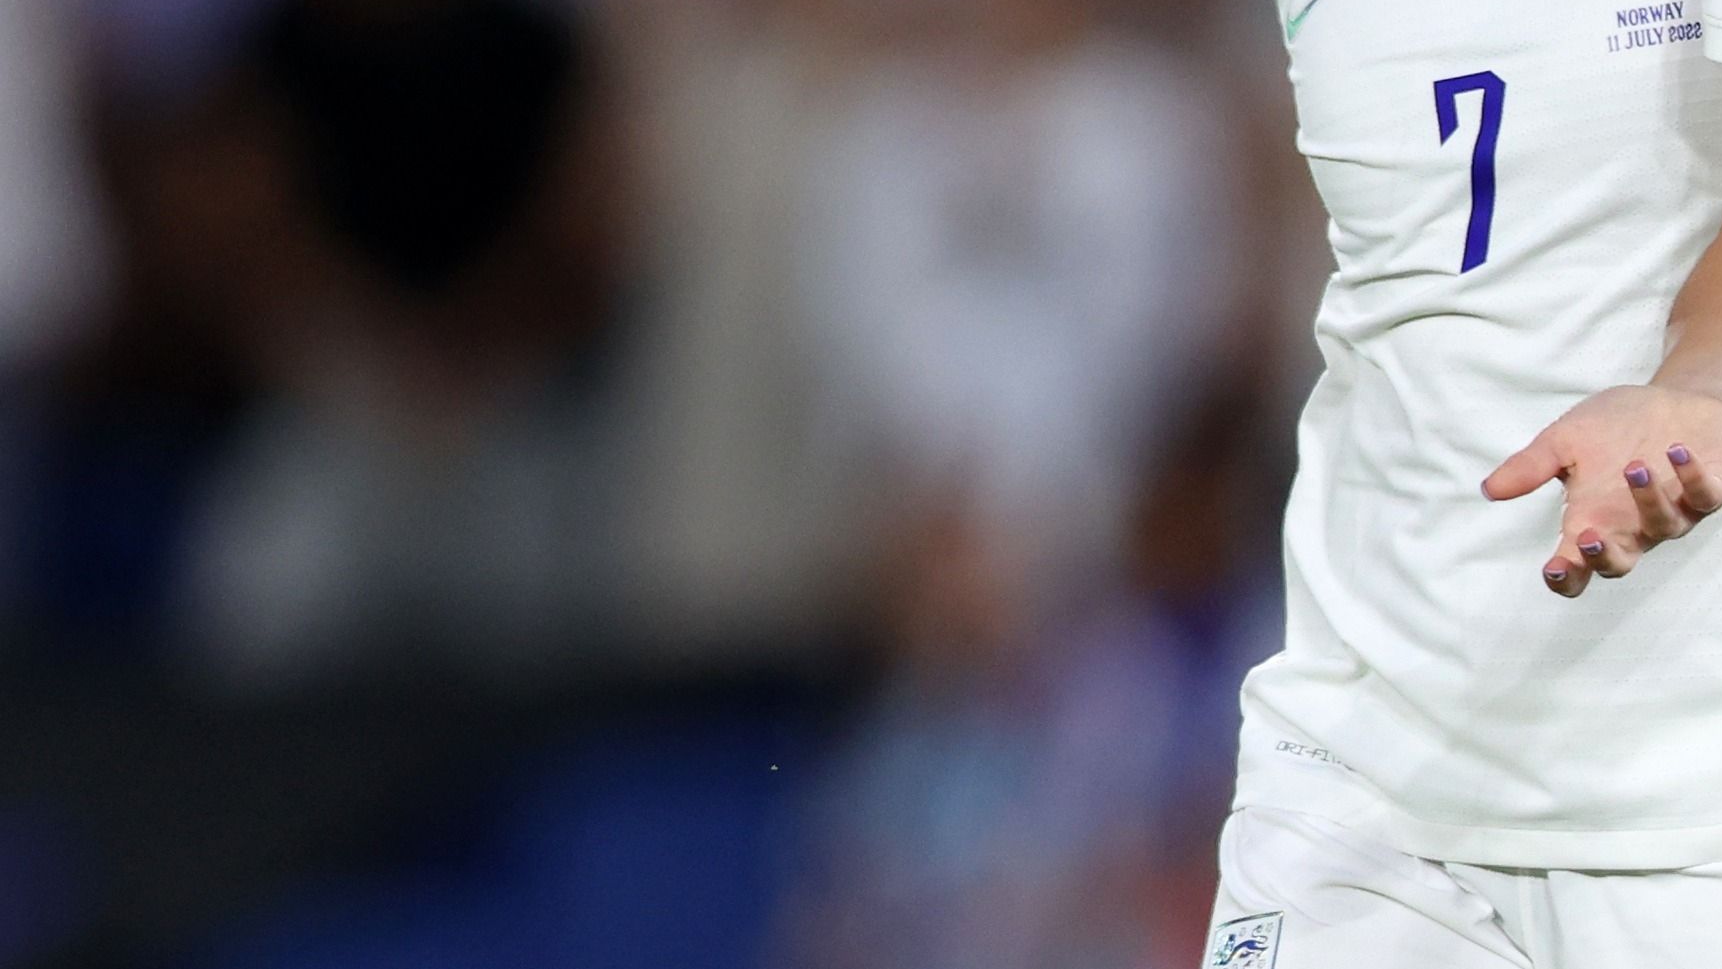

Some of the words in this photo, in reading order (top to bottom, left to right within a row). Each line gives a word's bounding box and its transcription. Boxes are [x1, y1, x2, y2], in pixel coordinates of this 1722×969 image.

[1616, 0, 1684, 28] NORWAY
[1625, 26, 1664, 50] JULY
[1668, 21, 1703, 43] 2022
[1434, 71, 1506, 273] 7
[1275, 740, 1341, 764] DRI-FI
